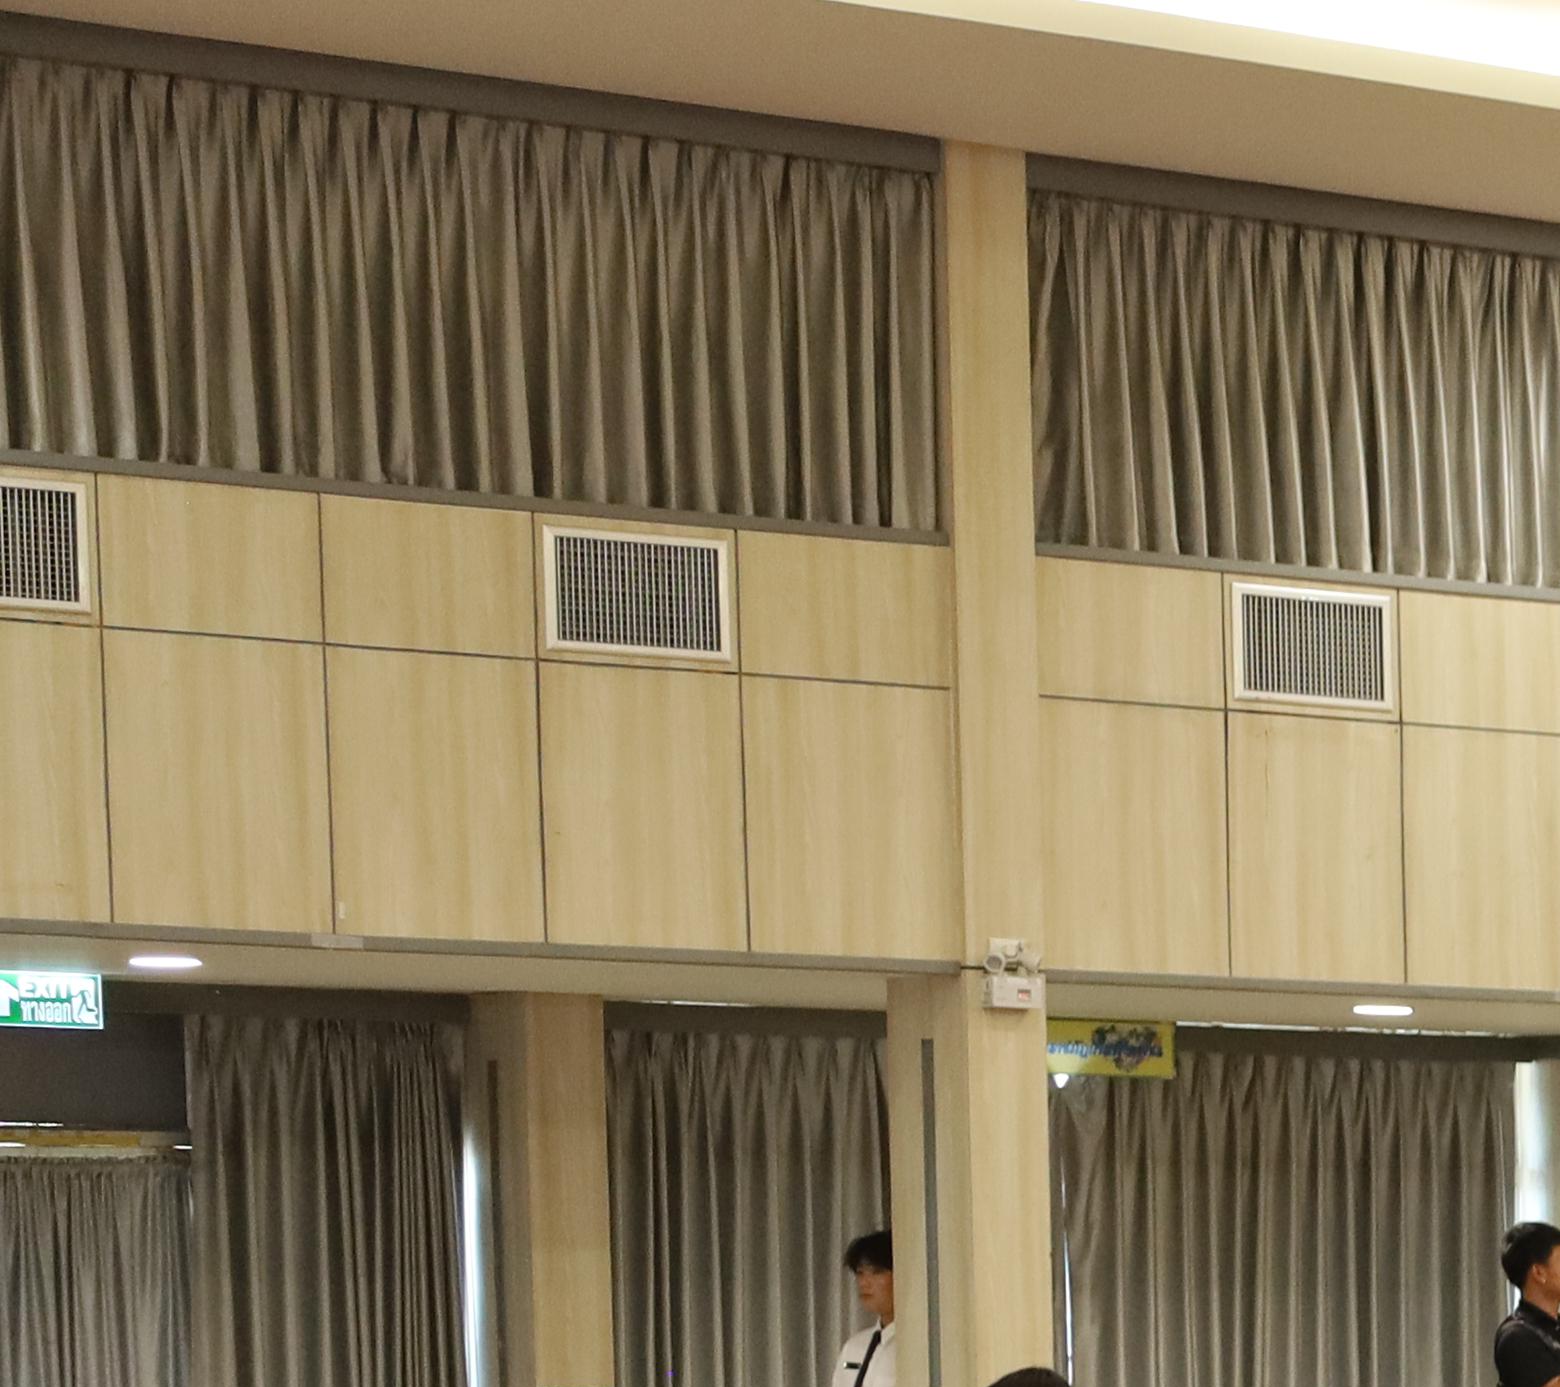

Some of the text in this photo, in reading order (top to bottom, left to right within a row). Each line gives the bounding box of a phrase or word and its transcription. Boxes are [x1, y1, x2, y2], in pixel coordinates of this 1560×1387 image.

[20, 977, 72, 999] EXIT
[21, 1000, 71, 1023] ทางออก
